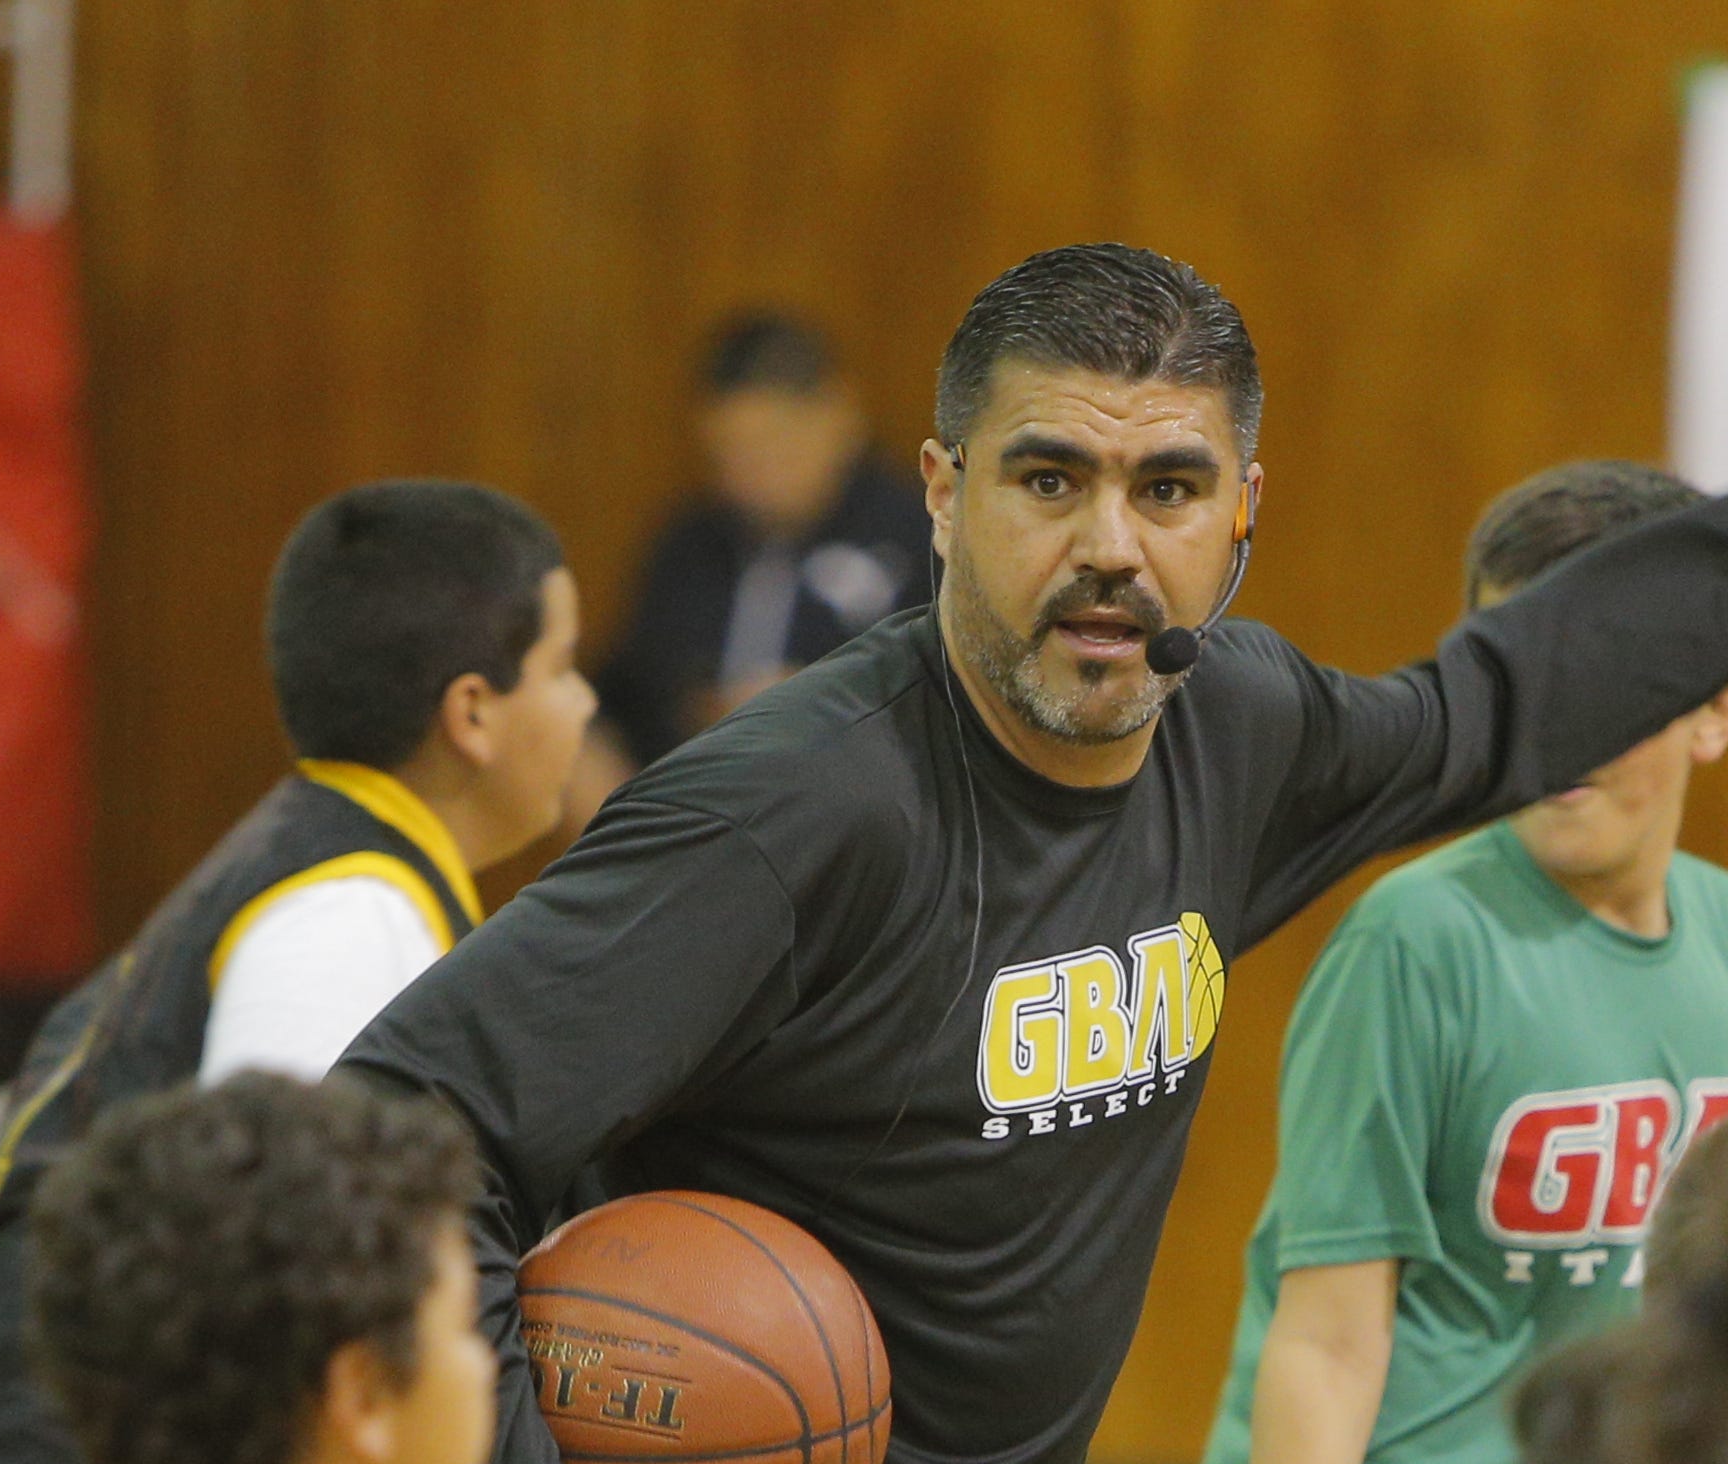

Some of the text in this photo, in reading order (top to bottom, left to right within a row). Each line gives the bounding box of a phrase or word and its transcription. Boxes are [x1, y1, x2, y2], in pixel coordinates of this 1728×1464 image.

[976, 923, 1196, 1116] GBA
[981, 1069, 1186, 1141] SELECT
[529, 1362, 685, 1432] TF-1
